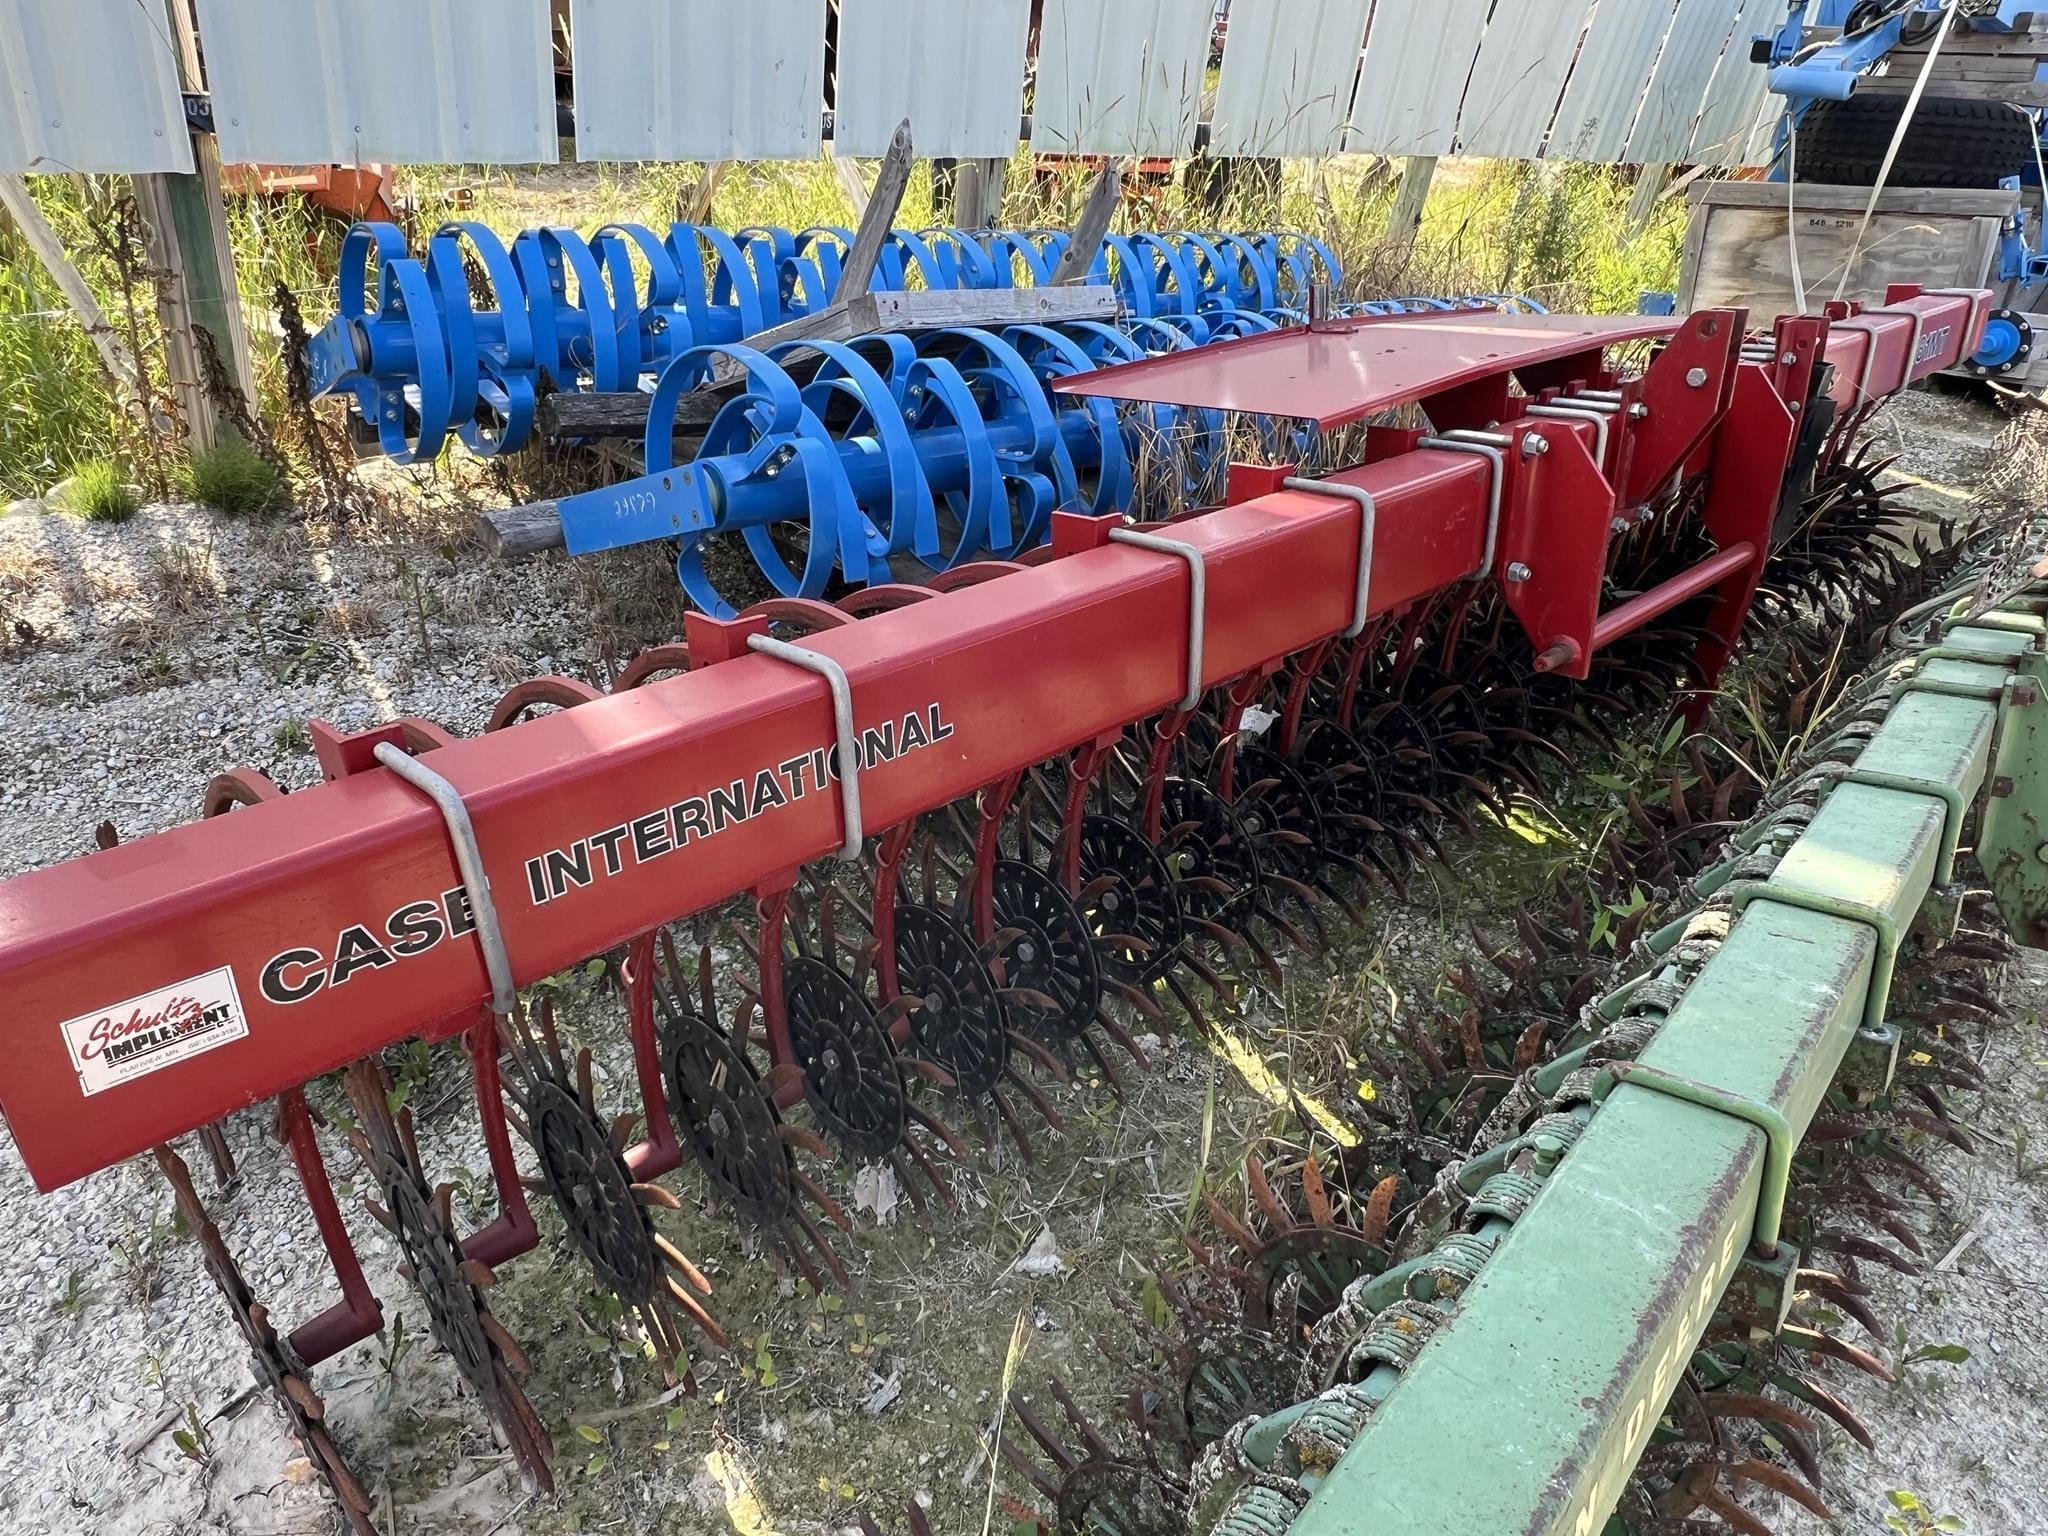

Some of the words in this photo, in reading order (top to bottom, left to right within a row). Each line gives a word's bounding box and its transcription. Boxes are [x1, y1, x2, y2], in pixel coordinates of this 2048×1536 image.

[258, 880, 486, 1004] CASE
[525, 702, 954, 905] INTERNATIONAL
[81, 997, 220, 1060] Schultz
[103, 1004, 230, 1063] IMPLEMENT
[1622, 1220, 1737, 1465] DEERE
